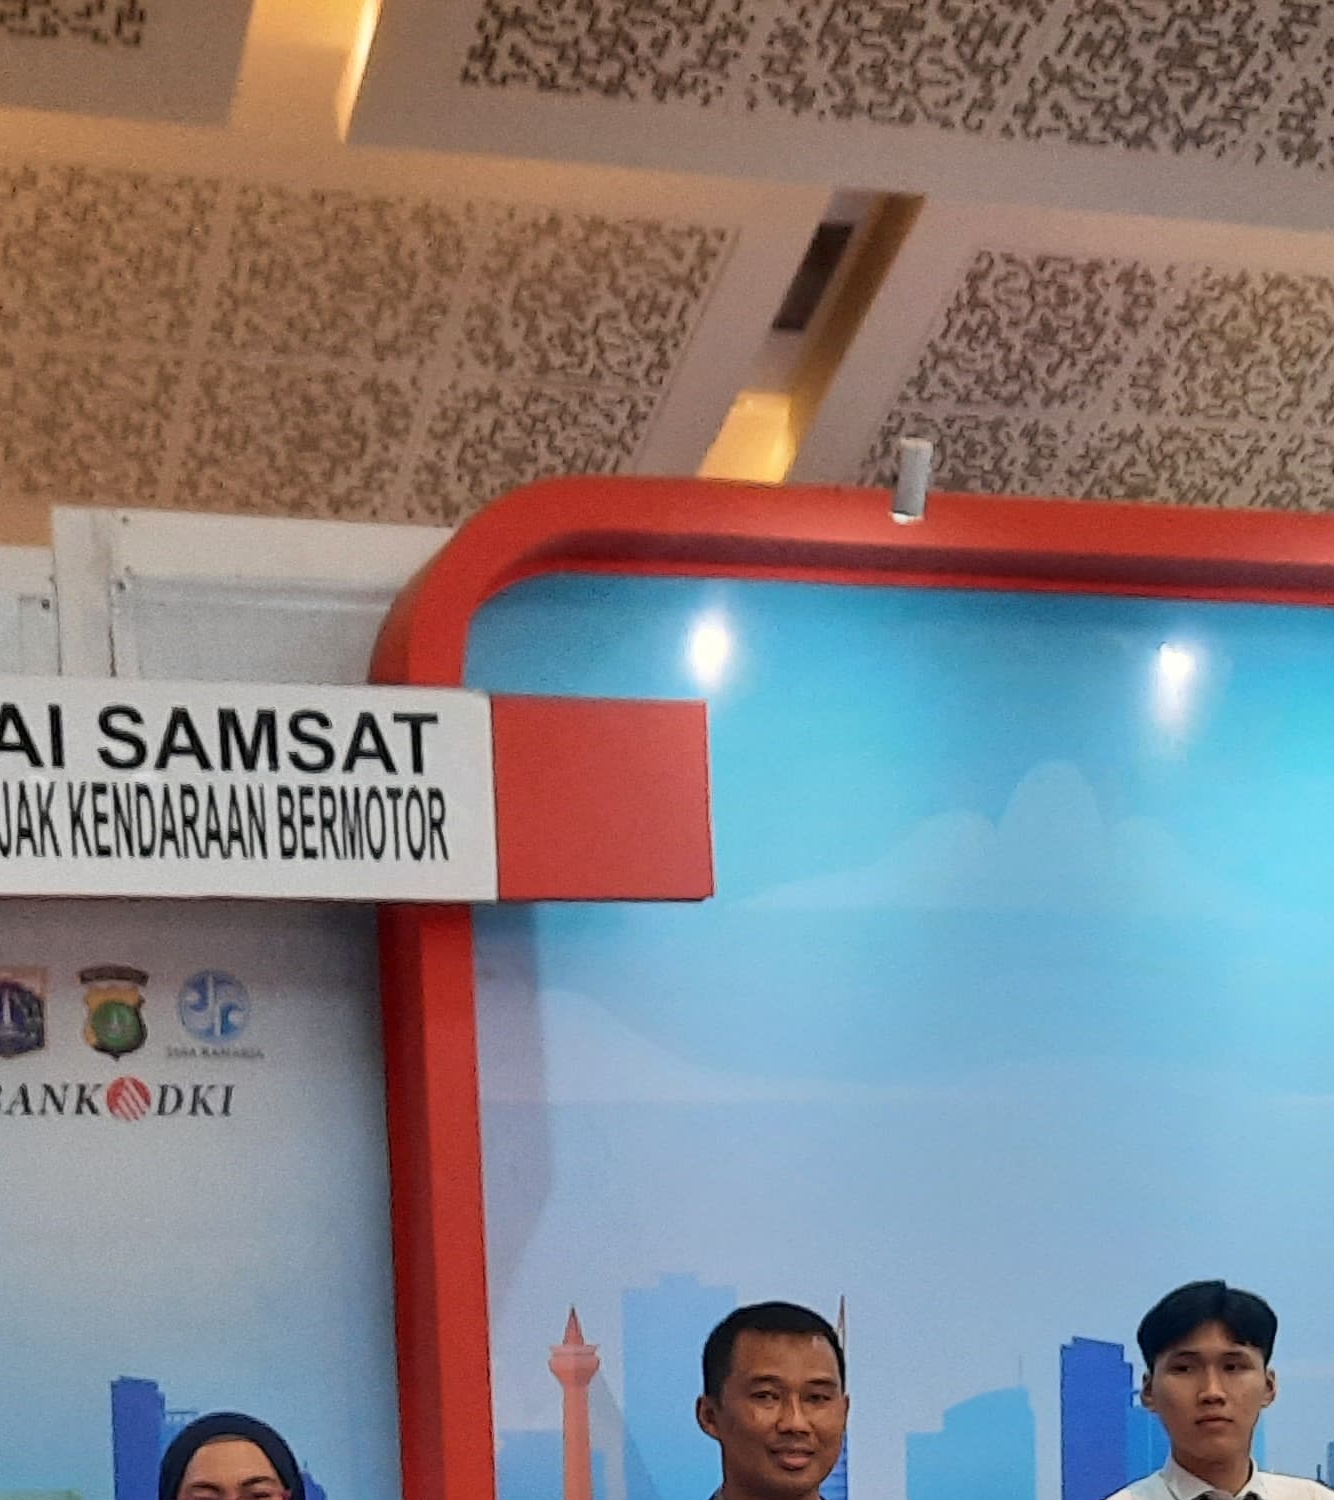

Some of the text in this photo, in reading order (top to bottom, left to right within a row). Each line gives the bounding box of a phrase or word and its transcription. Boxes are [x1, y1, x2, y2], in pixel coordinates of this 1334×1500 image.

[97, 704, 438, 774] SAMSAT
[67, 780, 268, 859] KENDARAAN
[276, 783, 449, 861] BERMOTOR
[155, 1083, 235, 1117] DKI
